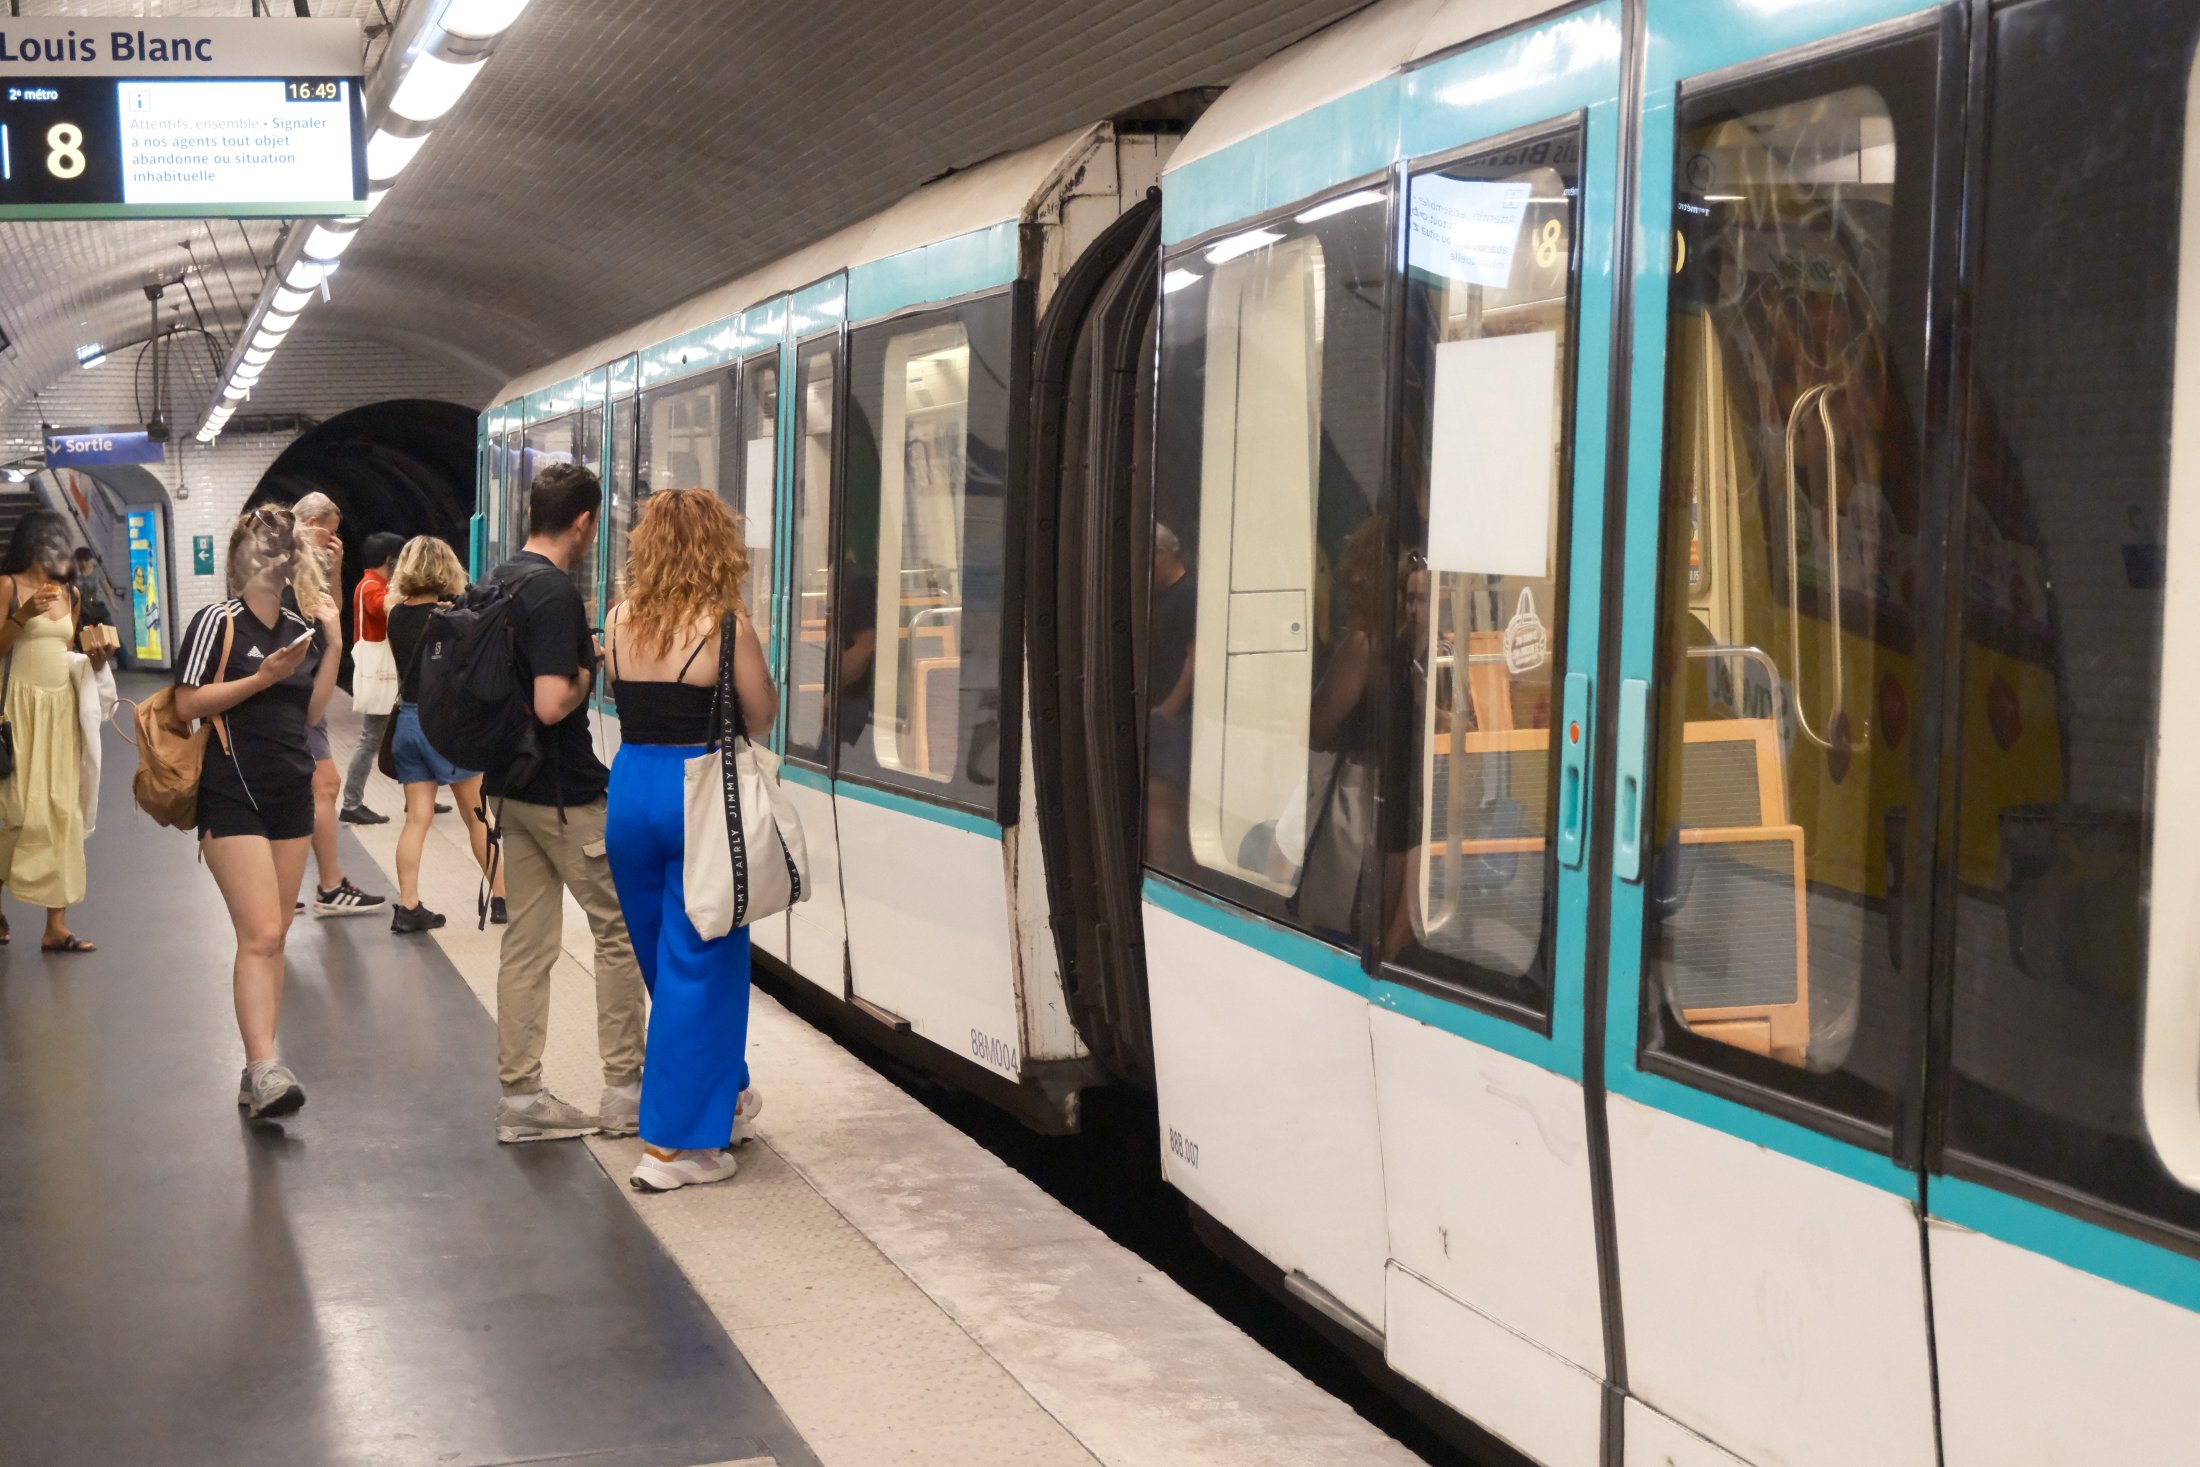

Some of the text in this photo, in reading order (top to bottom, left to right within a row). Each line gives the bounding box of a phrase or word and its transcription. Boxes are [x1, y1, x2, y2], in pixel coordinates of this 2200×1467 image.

[0, 30, 213, 62] Louis Blanc
[24, 88, 59, 101] métro
[288, 82, 338, 99] 16:49
[195, 118, 259, 130] ensemble
[272, 117, 327, 133] Signaler
[46, 122, 86, 179] 8
[131, 135, 290, 152] à nos agents tout objet
[132, 152, 296, 165] abandonné ou situation
[133, 169, 216, 183] inhabituelle
[65, 438, 112, 453] Sortie
[723, 719, 735, 766] FAIRLY
[726, 772, 738, 819] JIMMY
[731, 829, 744, 877] FAIRLY
